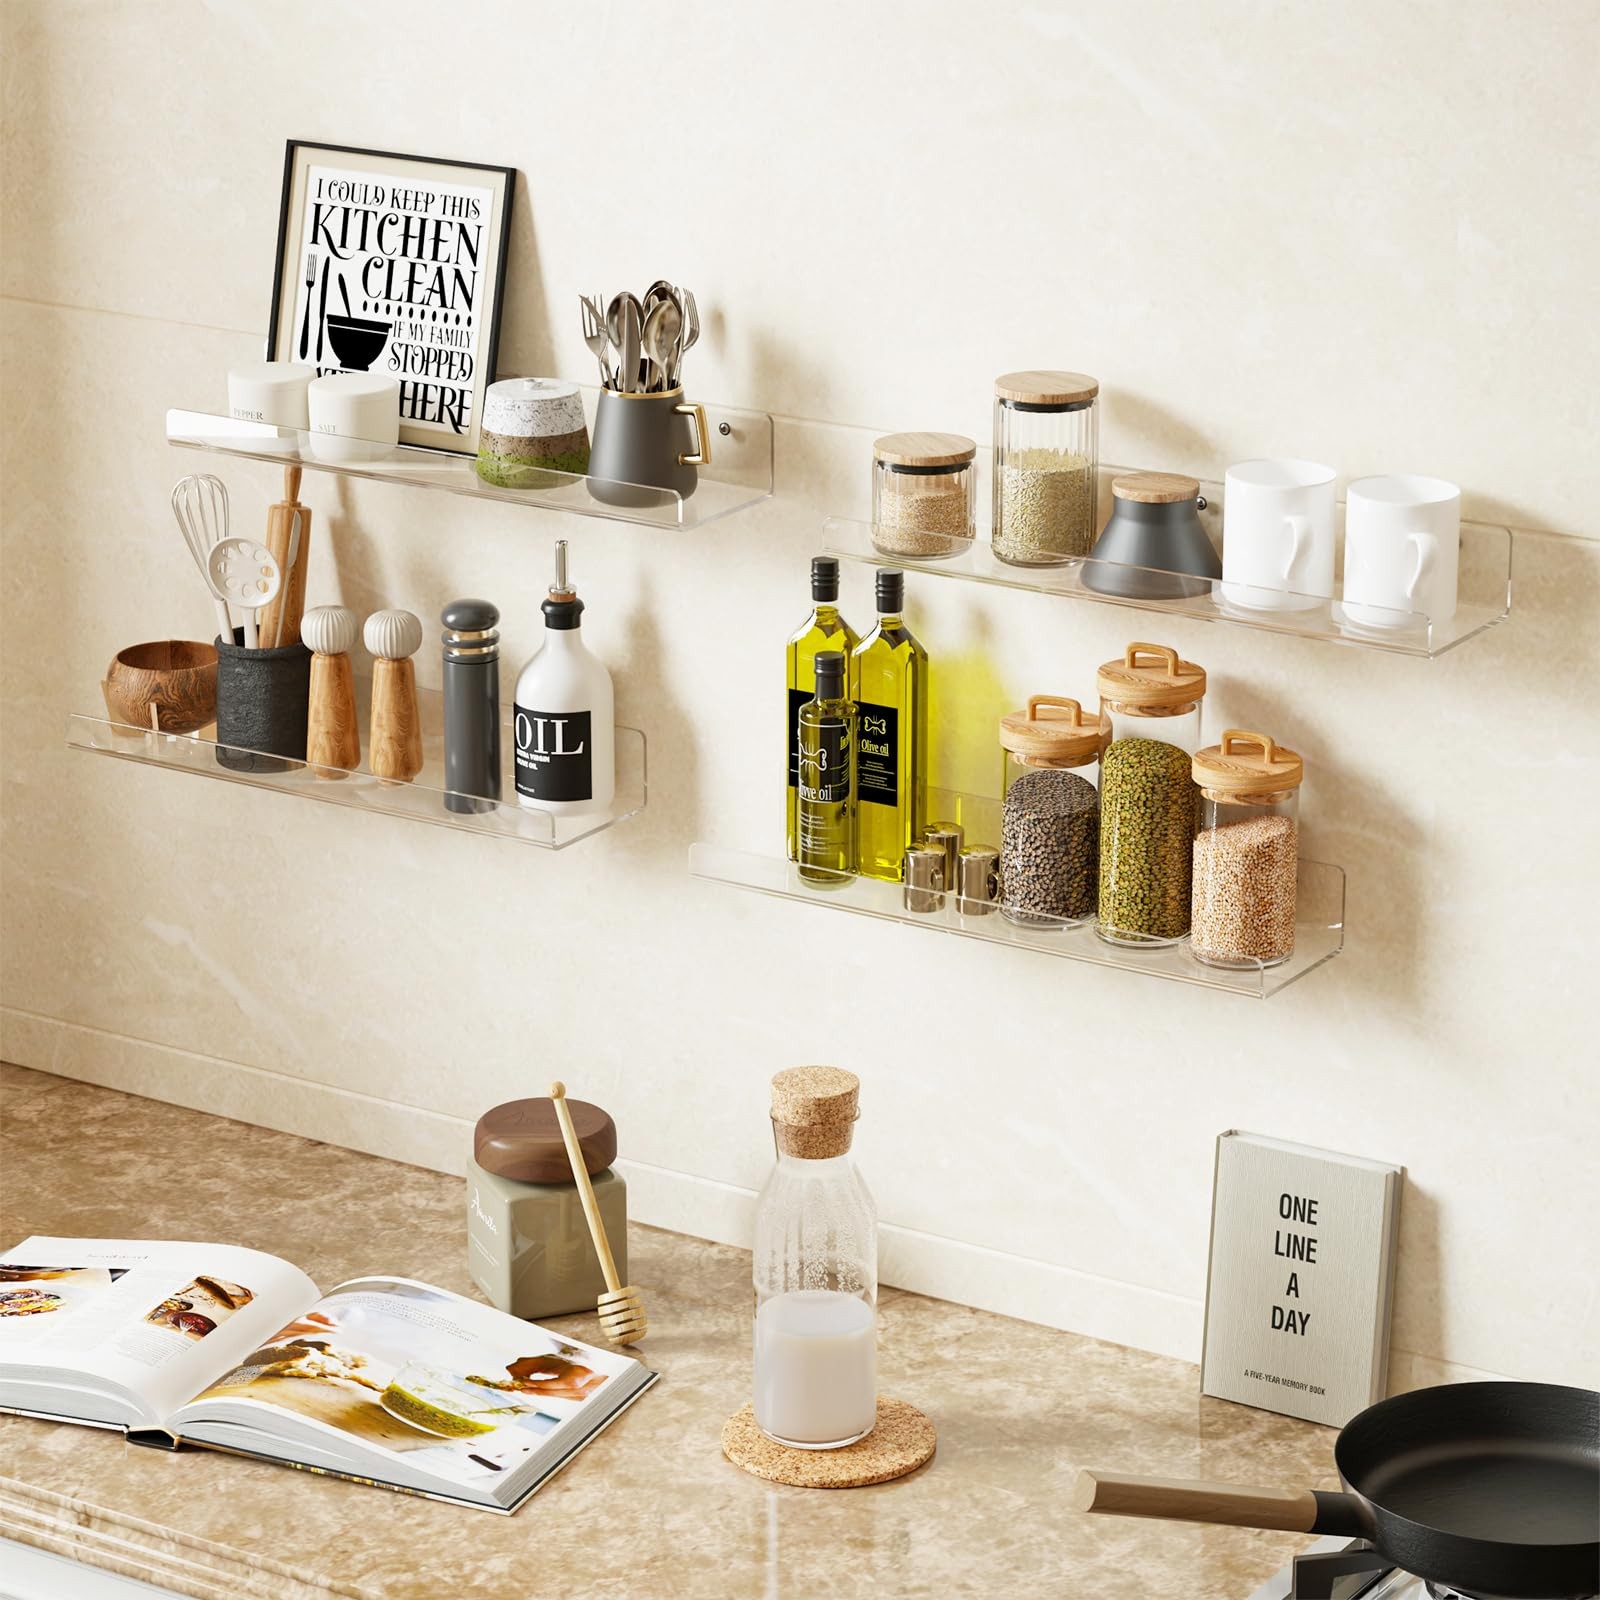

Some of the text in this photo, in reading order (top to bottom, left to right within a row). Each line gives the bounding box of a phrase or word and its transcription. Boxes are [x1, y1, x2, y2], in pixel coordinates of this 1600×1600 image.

[316, 178, 481, 220] I COULD KEEP THIS
[309, 203, 483, 267] KITCHEN
[362, 256, 479, 312] CLEAN
[393, 320, 474, 349] IF MY FAMILY
[388, 341, 474, 382] STOPPED
[233, 408, 263, 420] PEPPER
[399, 379, 473, 434] HERE
[515, 712, 584, 755] OIL
[861, 739, 889, 755] Olive oil
[818, 784, 833, 800] oil
[1279, 1193, 1319, 1225] ONE
[1274, 1231, 1318, 1264] LINE
[1286, 1273, 1299, 1298] A
[1271, 1306, 1311, 1336] DAY
[1244, 1369, 1326, 1395] A FIVE-YEAR MEMORY BOOK
